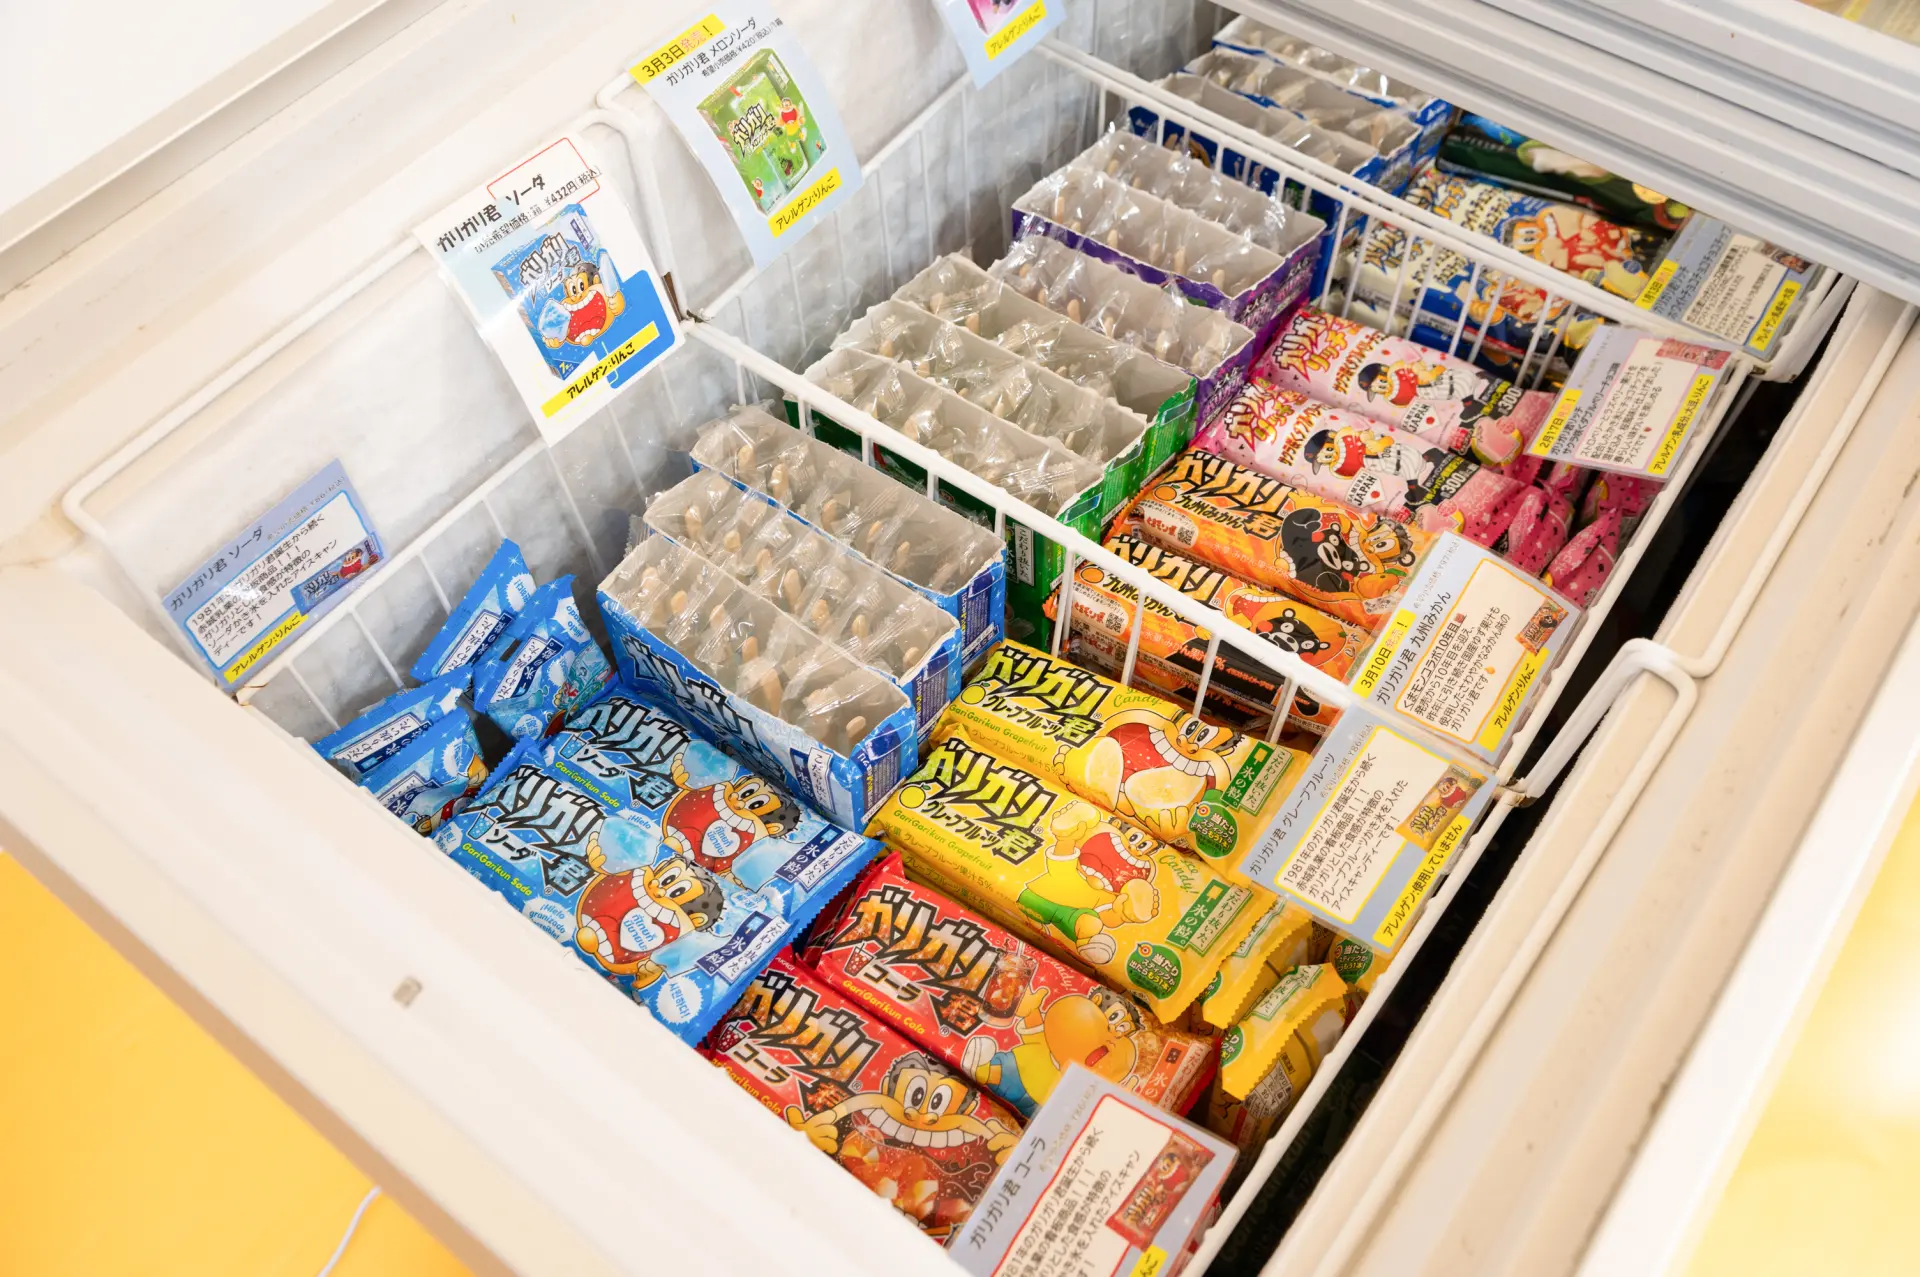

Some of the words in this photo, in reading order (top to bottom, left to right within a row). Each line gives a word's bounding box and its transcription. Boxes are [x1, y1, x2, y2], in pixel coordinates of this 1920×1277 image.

[663, 50, 710, 87] ガリガリ君
[707, 16, 759, 57] メロンソーダ
[433, 201, 503, 254] ガリガリ君
[503, 172, 547, 209] ソーダ
[565, 341, 636, 400] アレルゲン:りんご
[1159, 448, 1300, 540] ガリガリ君
[1173, 489, 1245, 533] 九州みかん
[1353, 474, 1377, 507] JAPAN
[166, 555, 229, 612] ガリガリ君
[227, 524, 266, 561] ソーダ
[1374, 647, 1417, 705] ガリガリ君
[1408, 588, 1452, 648] 九州みかん
[1400, 620, 1460, 710] くまモンコラボ10年目
[1413, 621, 1475, 716] 発売から10年目を迎え、
[1425, 603, 1501, 722] 昨年に引き続き国産ゆず果汁も
[1437, 612, 1511, 727] 使用したさわやかなみかん味の
[973, 644, 1117, 748] ガリガリ君
[987, 696, 1063, 737] グレープフルーツ
[1449, 673, 1490, 732] ガリガリ君です
[946, 699, 1003, 737] GariGarikun
[1000, 724, 1049, 758] Grapefruit
[551, 759, 602, 796] GariGarikun
[597, 788, 622, 810] Soda
[577, 743, 626, 779] ソーダ
[1231, 760, 1260, 809] 氷の粒。
[910, 738, 1055, 866] ガリガリ君
[927, 803, 1004, 850] グレープフルーツ
[1208, 811, 1239, 835] 当たり
[1247, 826, 1287, 876] ガリガリ君
[1279, 751, 1338, 827] グレープフルーツ
[1282, 751, 1377, 885] 1981年のガリガリ君誕生から続く
[458, 839, 515, 881] GariGarikun
[507, 873, 535, 898] Soda
[491, 827, 538, 862] ソーダ
[782, 842, 822, 880] 氷の粒。
[804, 833, 858, 885] こだわり抜いた、
[889, 806, 949, 847] GariGarikun
[943, 837, 996, 873] Grapefruit
[1294, 787, 1370, 892] 赤城乳業の看板商品！！！
[1306, 788, 1385, 898] ガリガリとした食感が特徴の
[1318, 777, 1409, 905] グレープフルーツかき氷を入れた
[1331, 814, 1400, 911] アイスキャンディーです！
[527, 905, 568, 936] granizado
[539, 900, 566, 922] ¡Hielo
[1174, 898, 1211, 947] 氷の粒。
[1196, 886, 1242, 948] こだわり抜いた、
[705, 928, 745, 973] 氷の粒。
[727, 919, 785, 977] こだわり抜いた、
[832, 885, 1006, 1039] ガリガリ君
[1139, 957, 1178, 986] スティックが
[1150, 952, 1182, 978] 当たり
[839, 977, 904, 1022] GariGarikun
[901, 1014, 928, 1036] Cola
[864, 964, 923, 1002] コーラ
[705, 1055, 766, 1100] ariGarikun
[731, 1052, 790, 1085] コーラ
[967, 1177, 1022, 1251] ガリガリ君
[1012, 1134, 1049, 1179] コーラ
